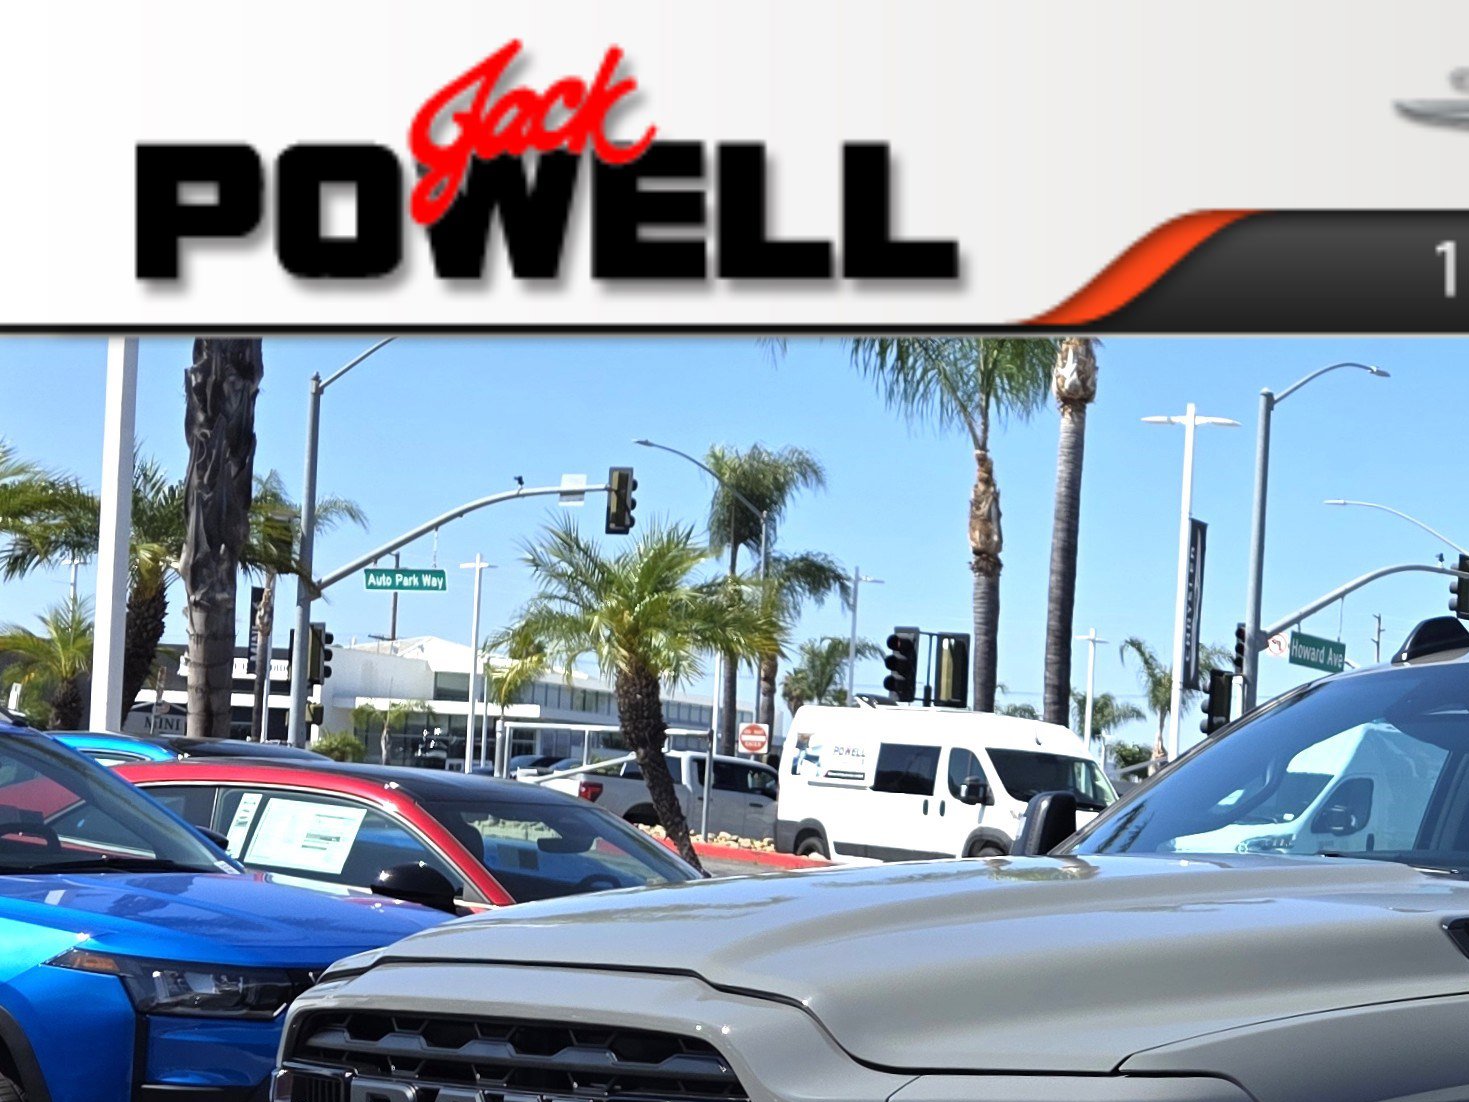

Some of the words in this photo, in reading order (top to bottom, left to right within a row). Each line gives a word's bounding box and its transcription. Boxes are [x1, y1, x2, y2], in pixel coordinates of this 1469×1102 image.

[368, 573, 392, 586] Auto
[395, 573, 419, 586] Park
[422, 574, 443, 590] Way
[1290, 638, 1325, 664] Howard
[1326, 650, 1343, 668] Ave
[833, 746, 866, 757] POWELL
